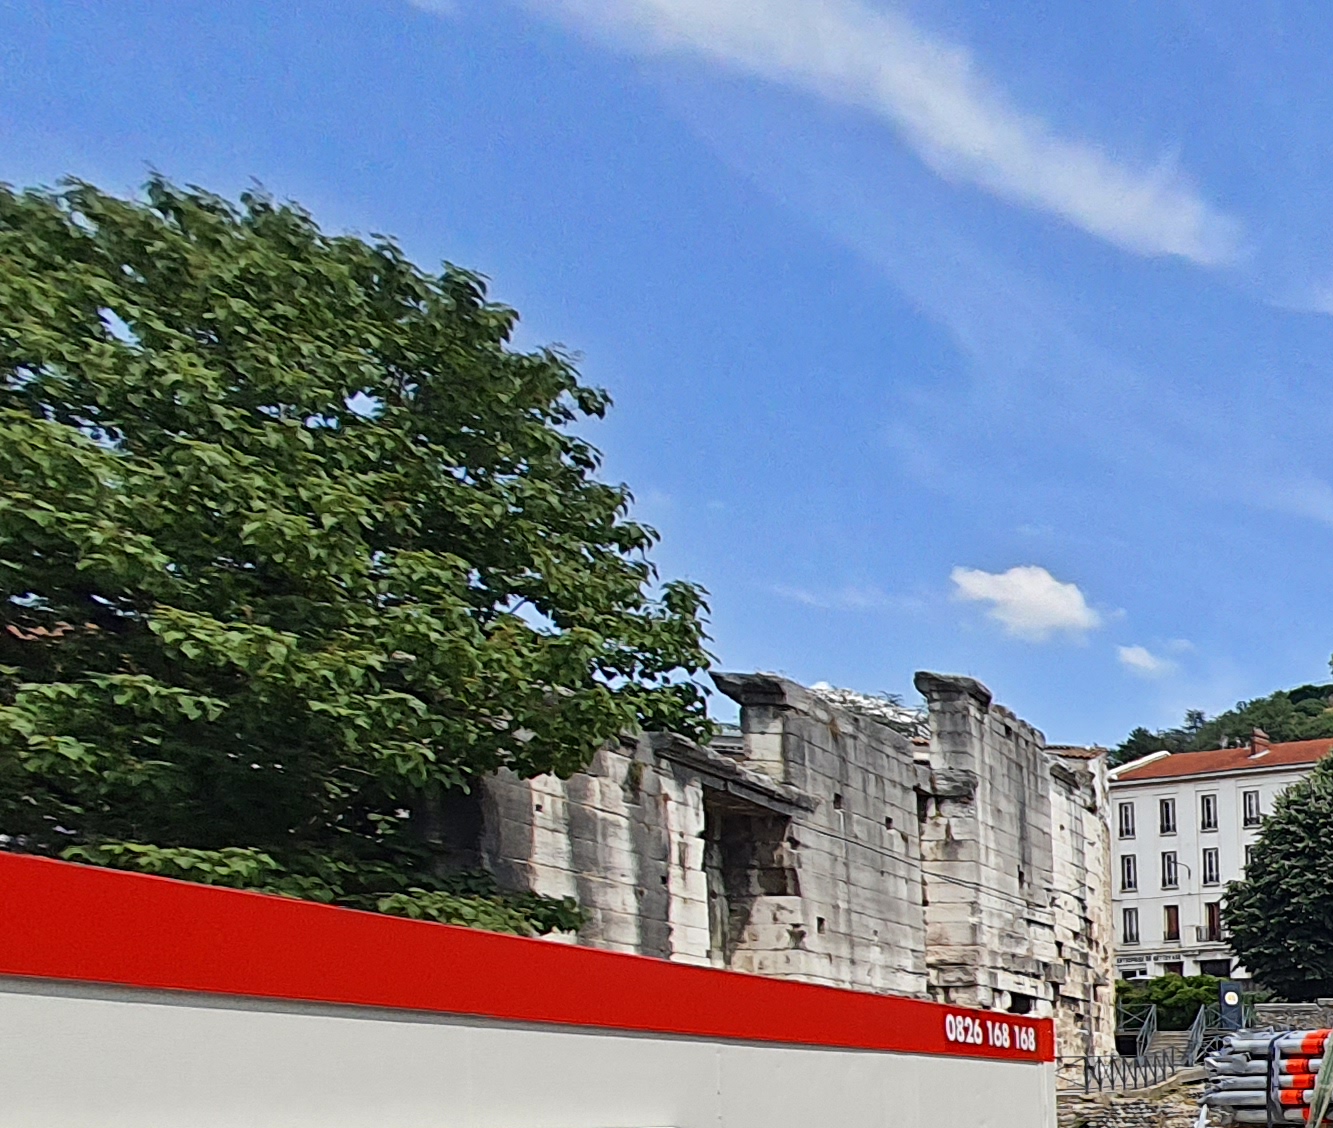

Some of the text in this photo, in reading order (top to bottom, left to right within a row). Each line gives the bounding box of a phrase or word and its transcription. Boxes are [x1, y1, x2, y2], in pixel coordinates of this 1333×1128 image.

[945, 1013, 1036, 1052] 0826 168 168
